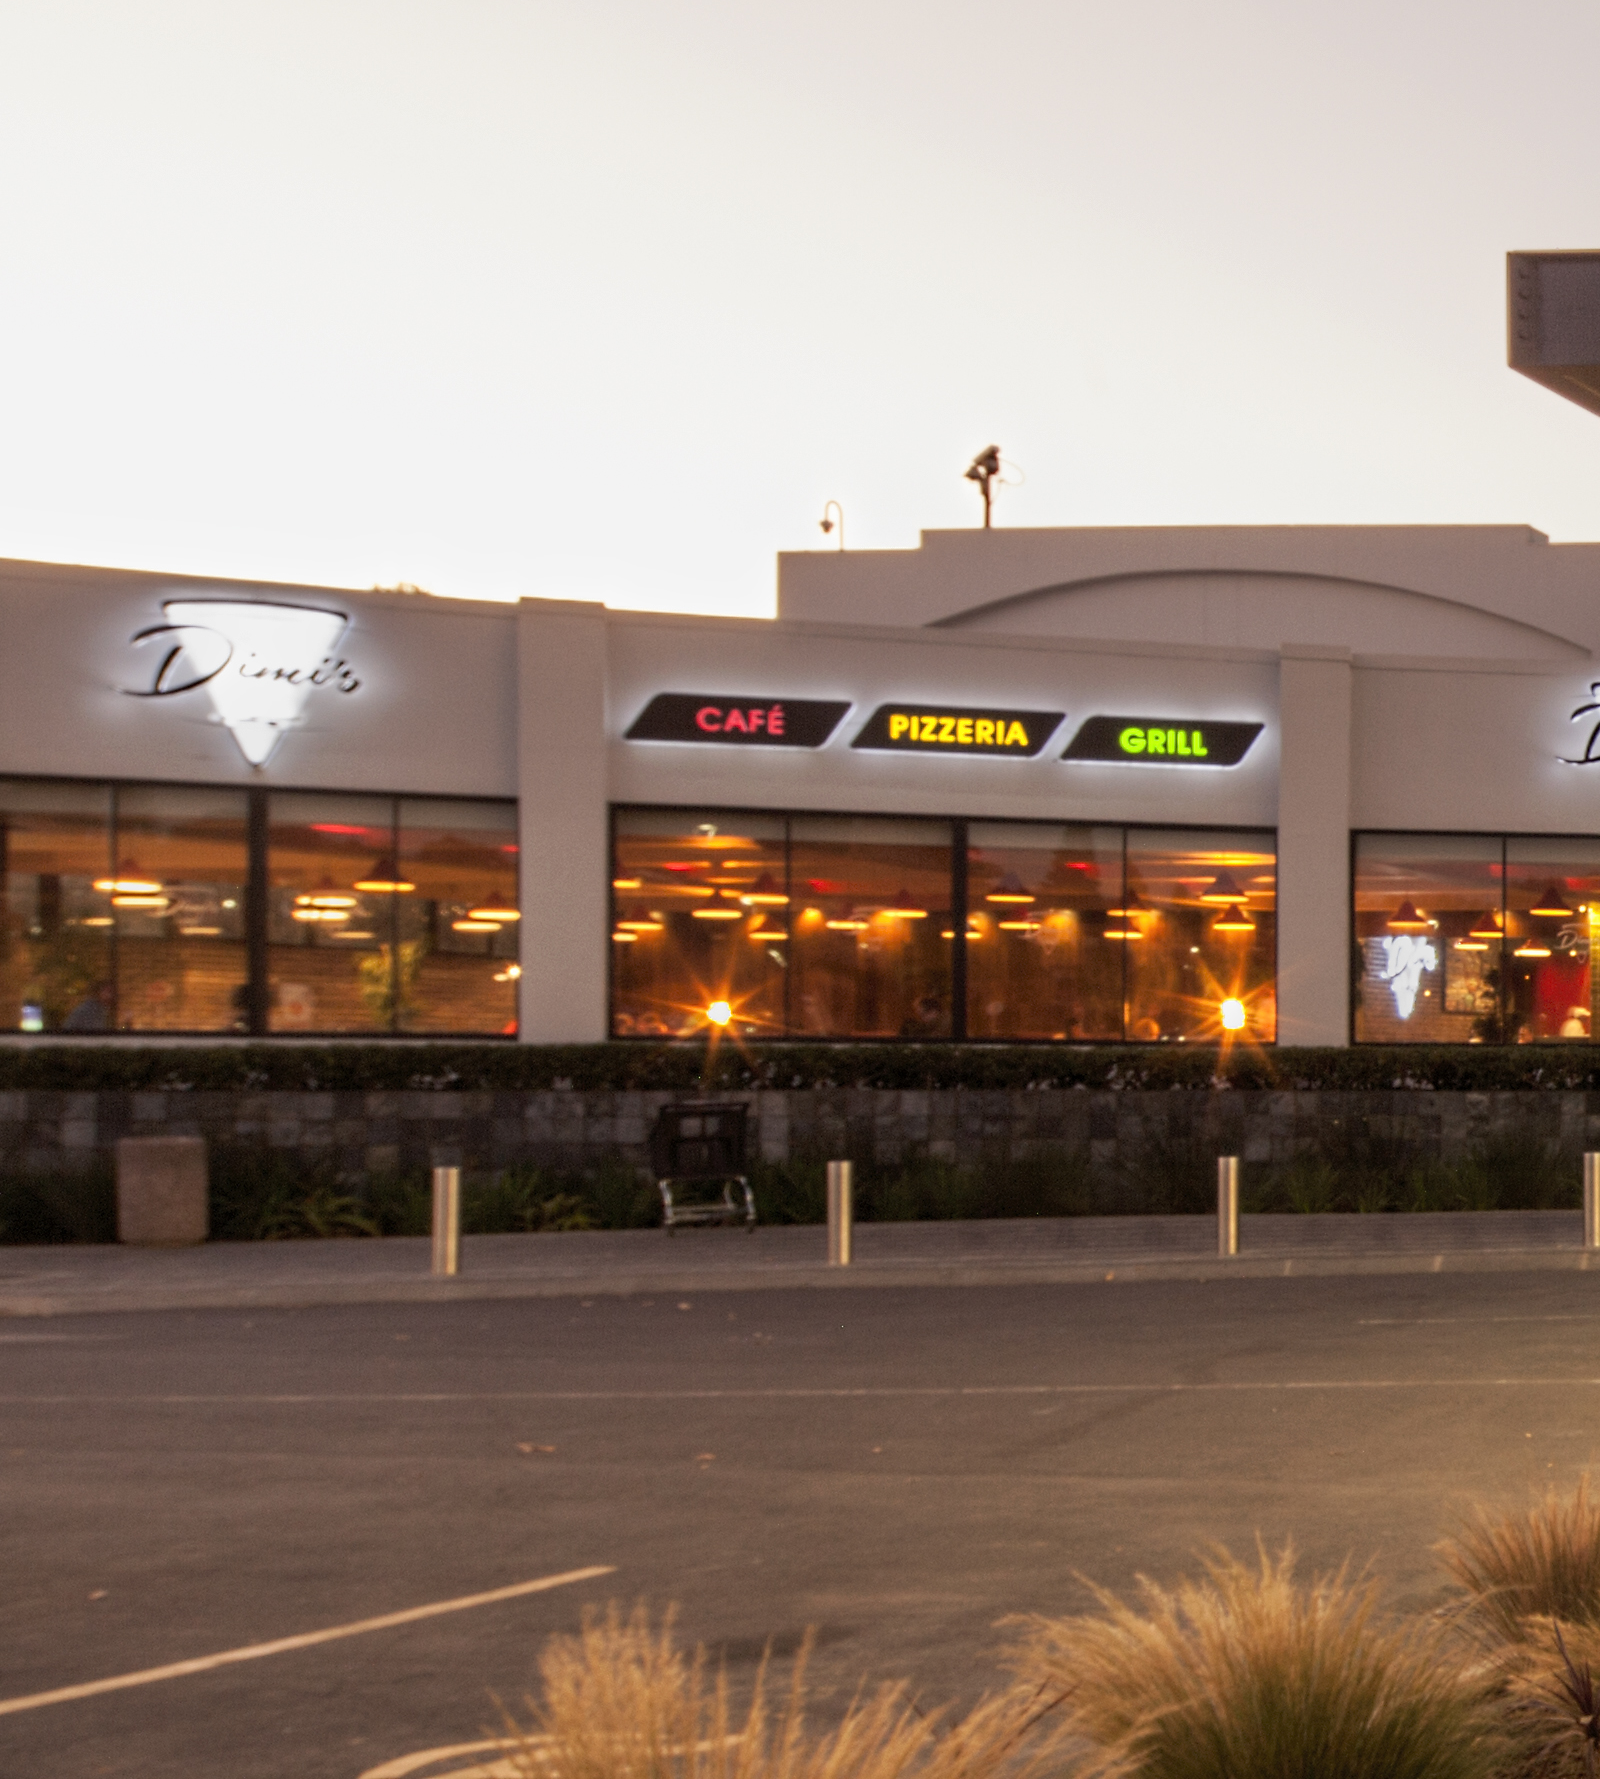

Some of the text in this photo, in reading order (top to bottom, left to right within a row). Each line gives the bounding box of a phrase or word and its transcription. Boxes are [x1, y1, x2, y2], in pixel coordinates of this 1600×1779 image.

[112, 624, 361, 697] Dimi's
[695, 704, 786, 736] CAFÉ
[889, 714, 1030, 747] PIZZERIA
[1120, 727, 1208, 757] GRILL
